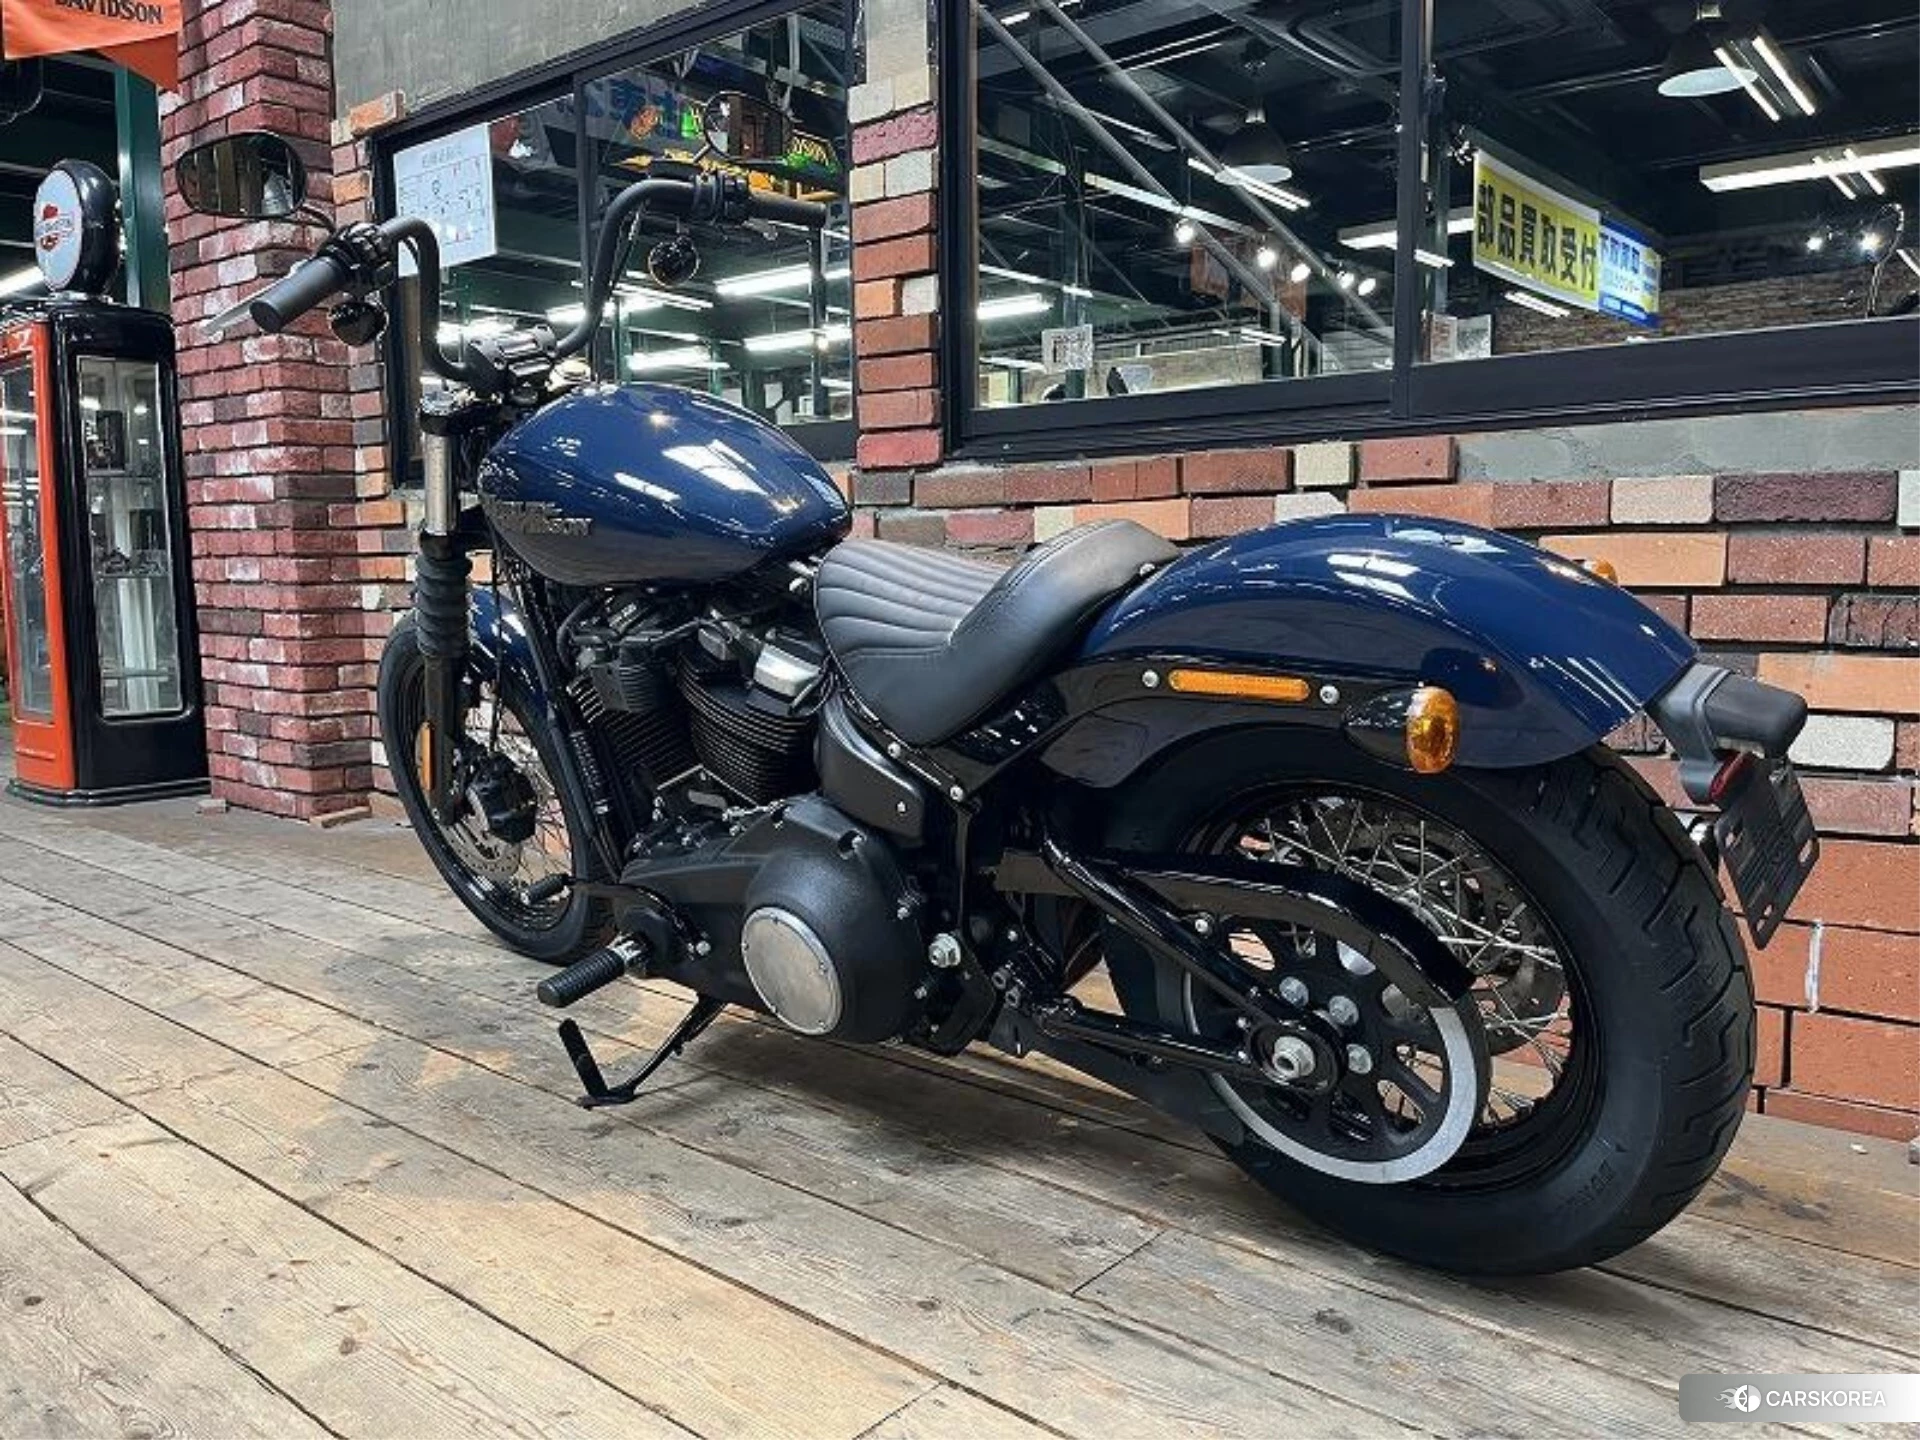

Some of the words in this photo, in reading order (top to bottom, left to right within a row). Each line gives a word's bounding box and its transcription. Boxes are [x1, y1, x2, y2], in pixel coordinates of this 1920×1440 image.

[1478, 180, 1598, 291] 部品買取受付
